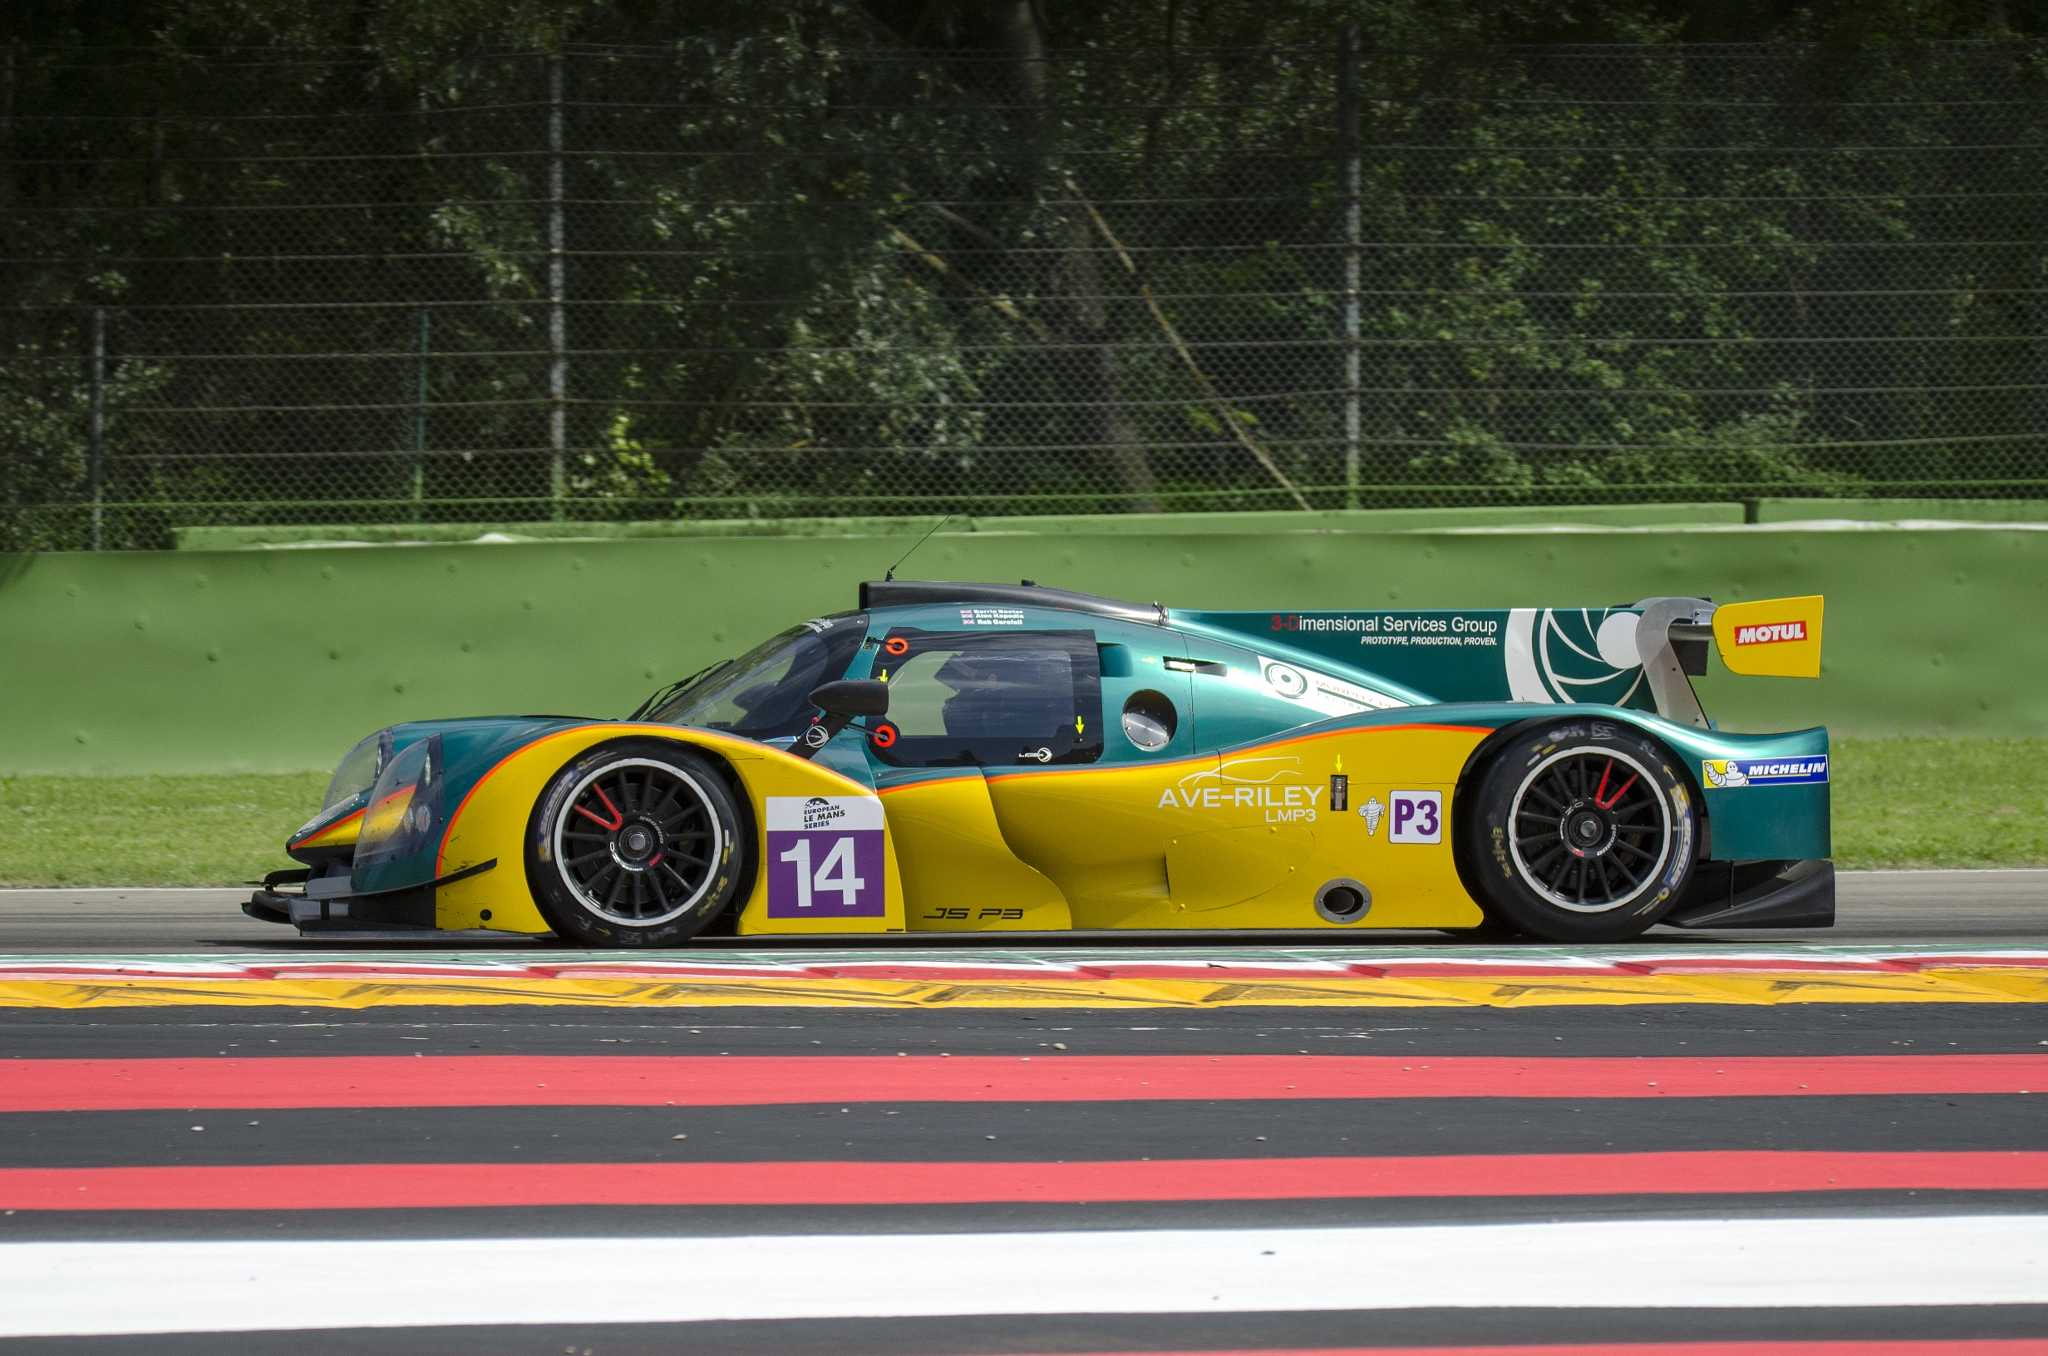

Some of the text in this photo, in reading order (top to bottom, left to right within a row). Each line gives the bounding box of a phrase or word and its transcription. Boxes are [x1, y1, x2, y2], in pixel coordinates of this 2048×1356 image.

[1271, 615, 1498, 636] 3-Dimensional Services Group
[1738, 624, 1805, 644] MOTUL
[1361, 636, 1498, 647] PROTOTYPE, PRODUCTION, PROVEN.
[1315, 680, 1374, 703] MURPHY
[1749, 761, 1826, 775] MICHELIN
[1157, 786, 1324, 808] AVE-RILEY
[803, 804, 841, 815] EUROPEAN
[803, 809, 846, 823] LE MANS
[1265, 809, 1317, 823] LMP3
[1394, 799, 1440, 836] P3
[803, 820, 831, 830] SERIES
[780, 836, 865, 907] 14
[923, 908, 1024, 919] JS P3
